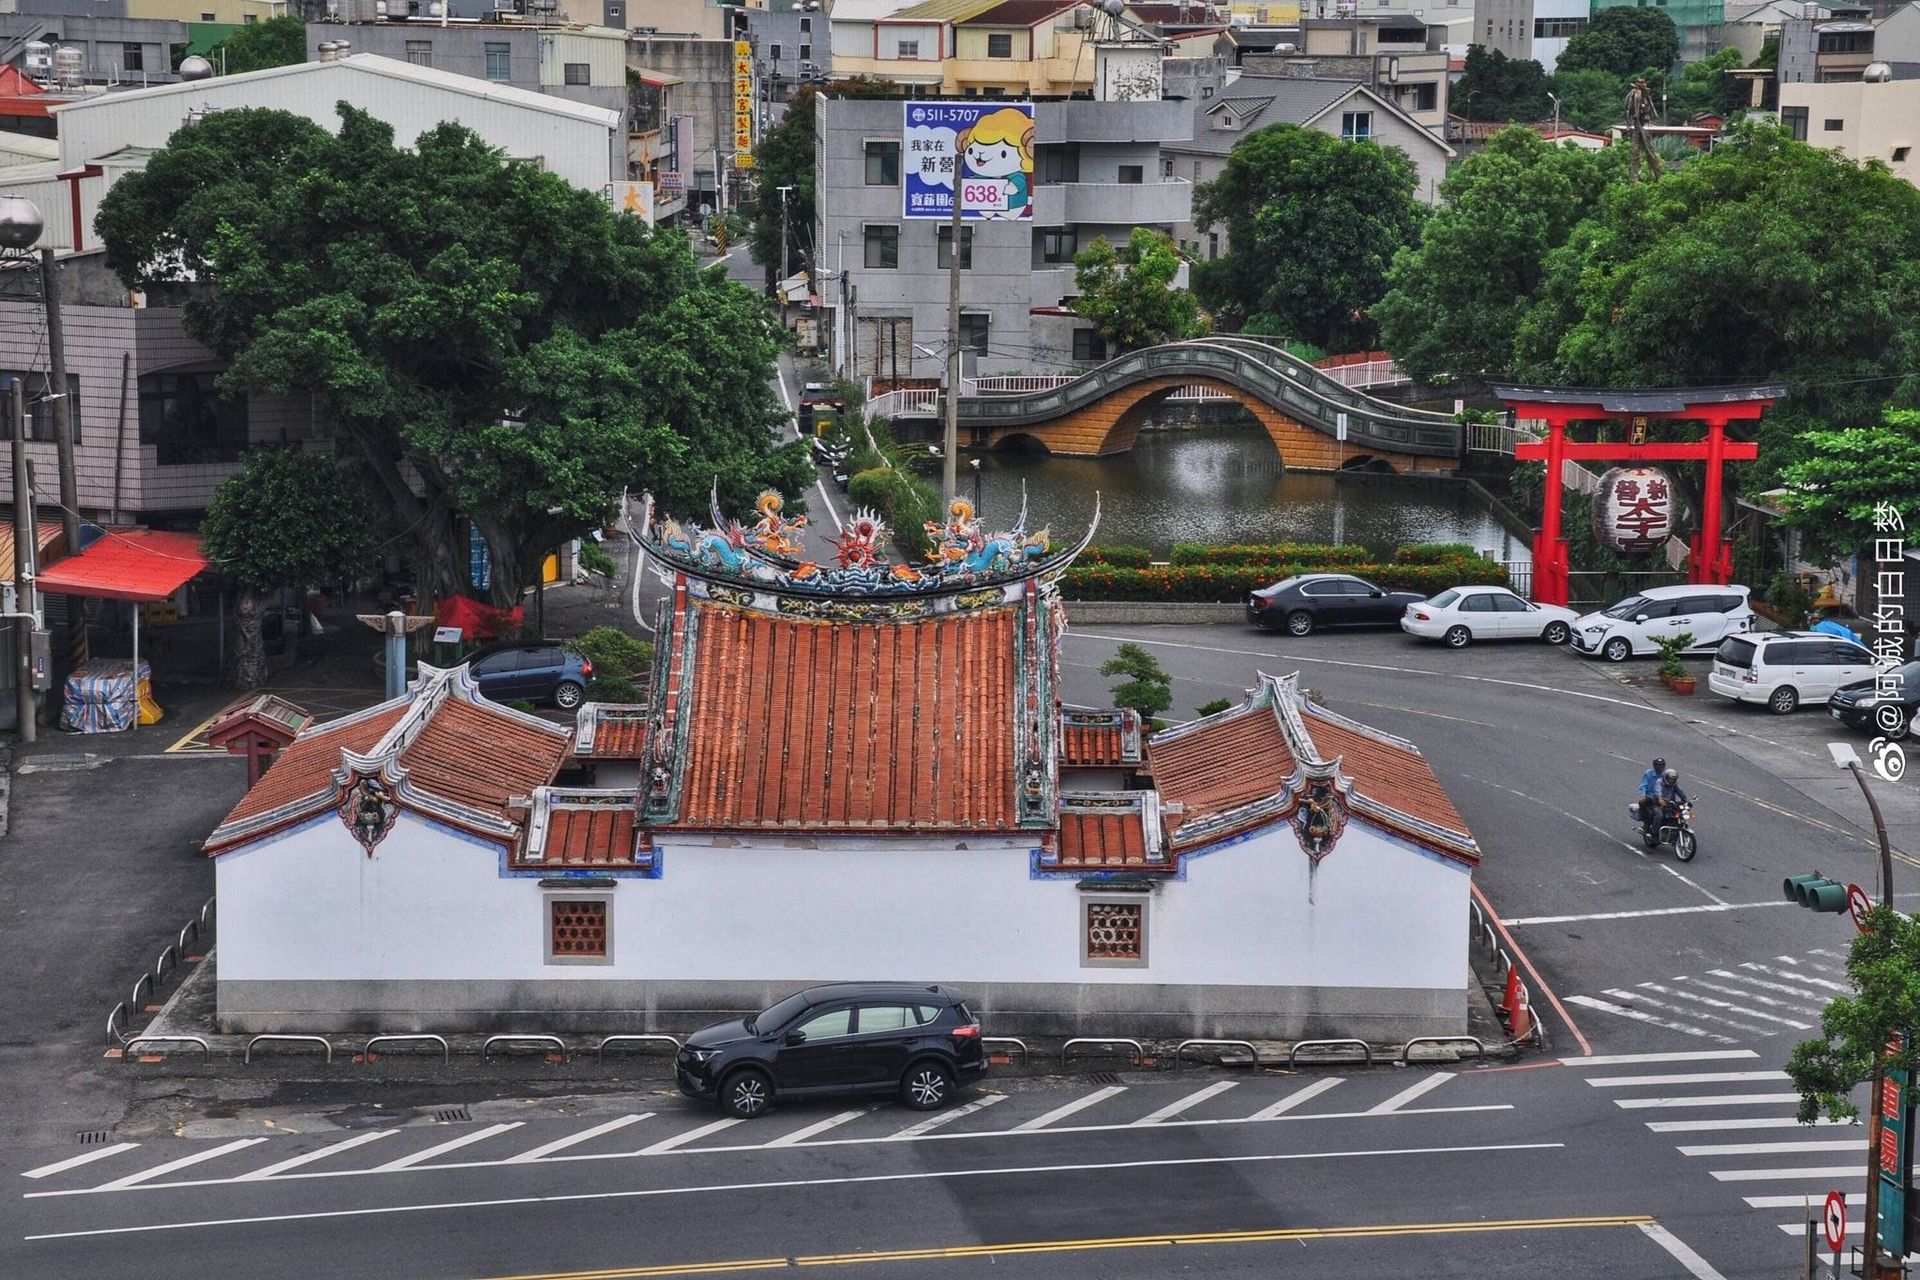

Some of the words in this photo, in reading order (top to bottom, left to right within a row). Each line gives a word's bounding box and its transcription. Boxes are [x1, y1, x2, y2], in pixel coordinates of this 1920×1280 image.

[926, 109, 979, 121] 511-5707
[911, 140, 945, 151] 我家在
[921, 156, 954, 173] 新營
[964, 185, 997, 203] 638
